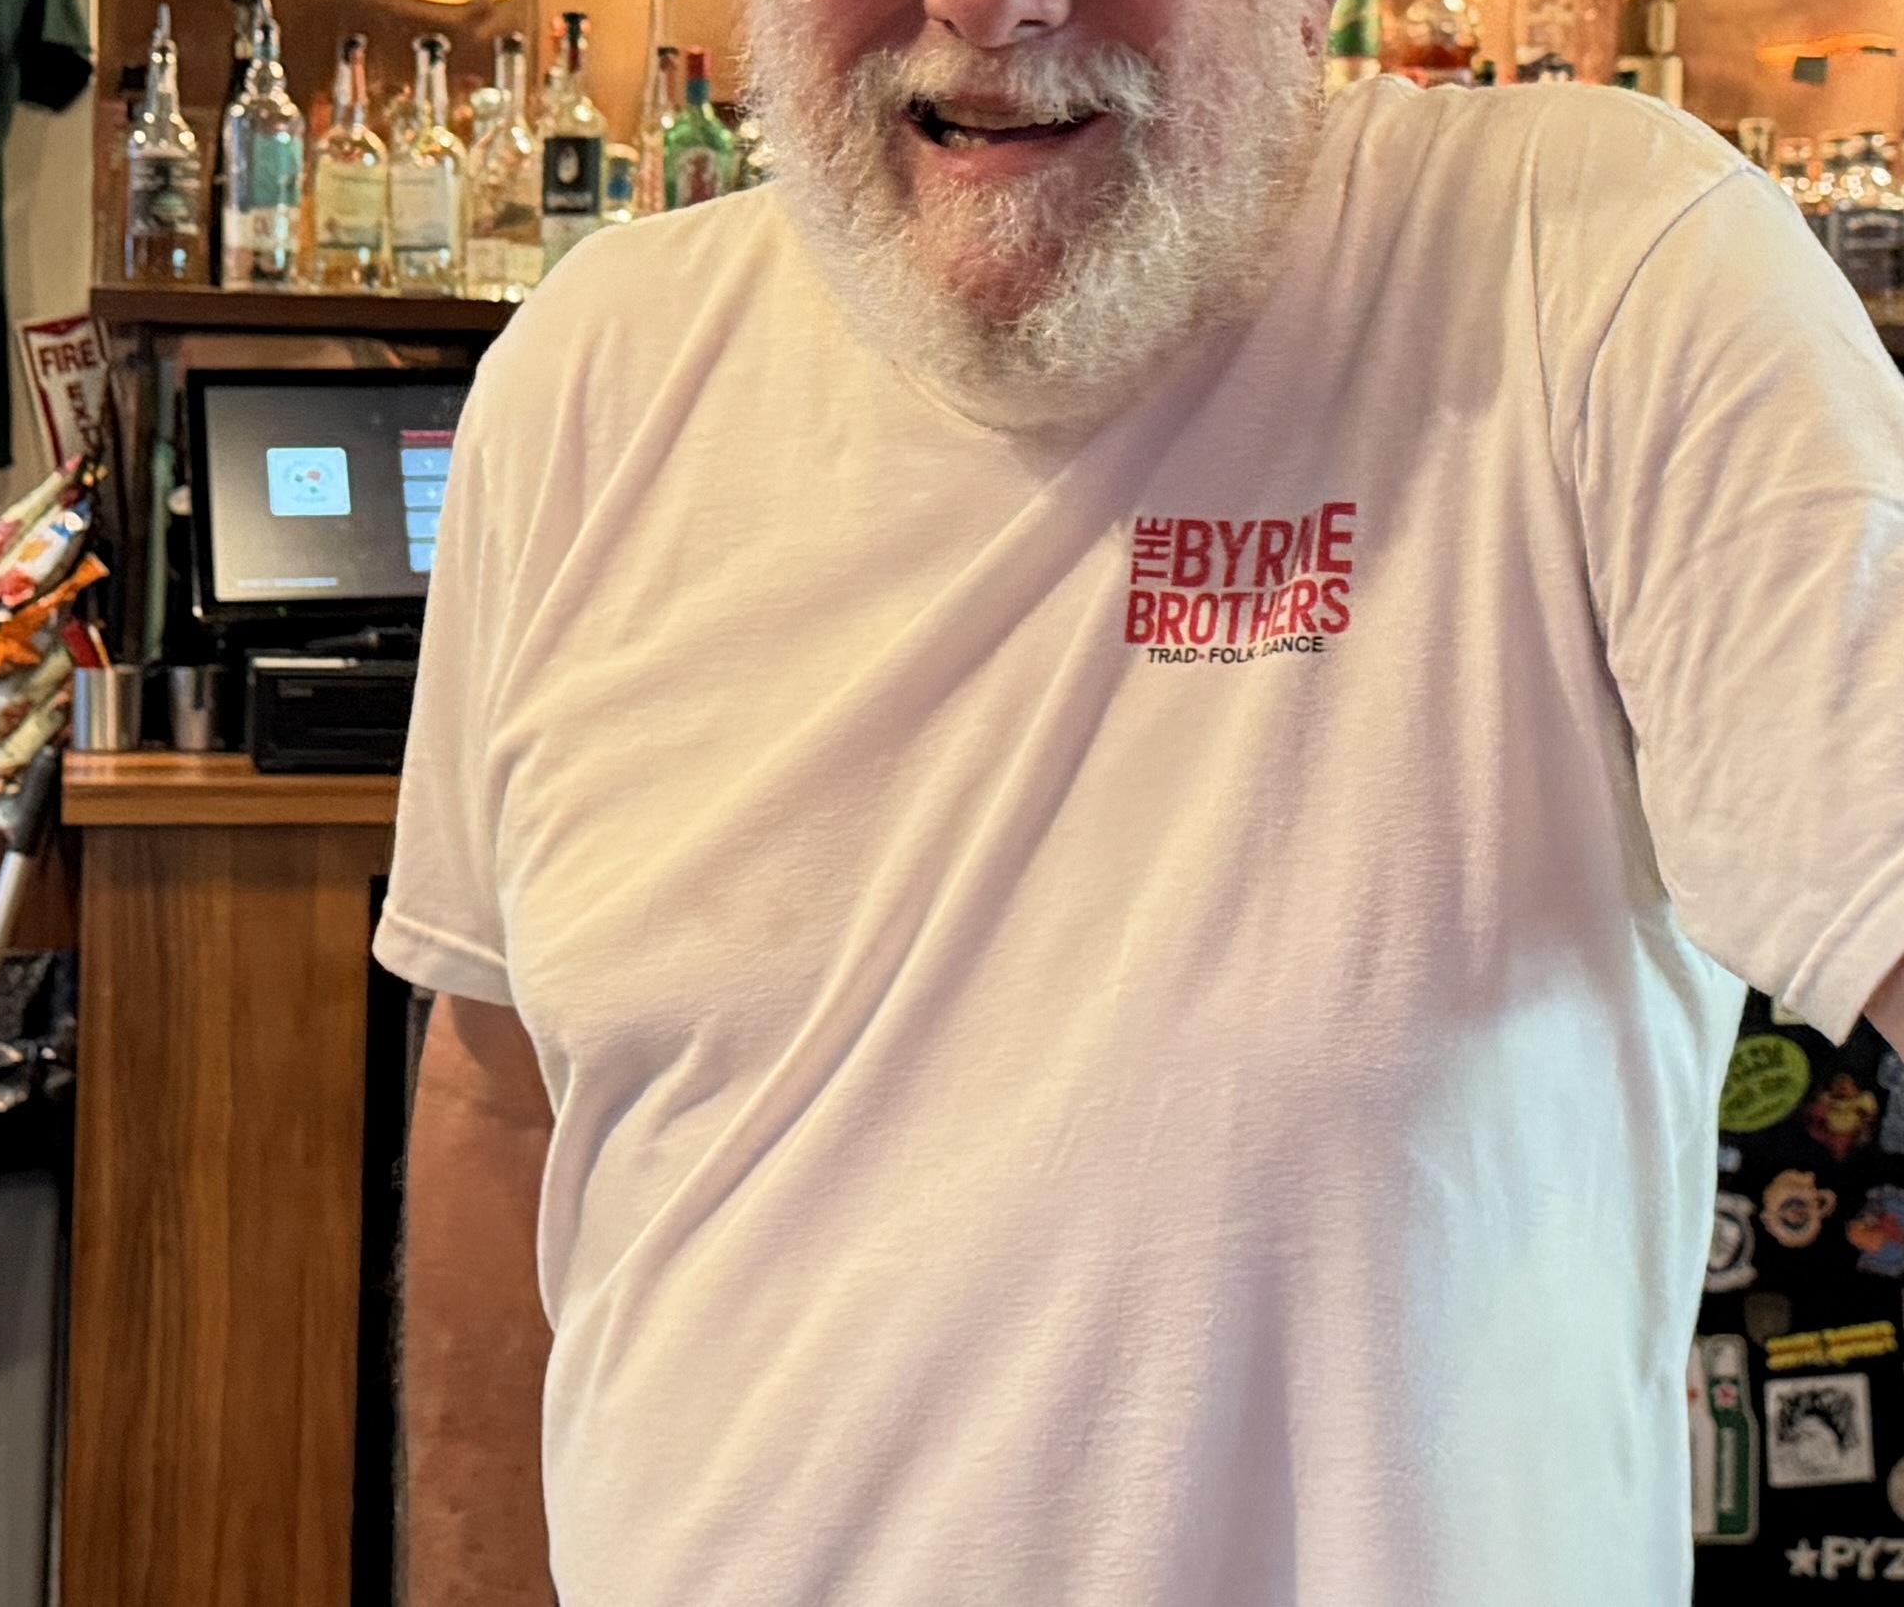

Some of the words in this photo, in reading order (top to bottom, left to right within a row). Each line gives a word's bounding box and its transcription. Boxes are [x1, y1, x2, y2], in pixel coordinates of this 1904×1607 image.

[37, 339, 98, 378] FIRE
[1130, 516, 1174, 586] THE
[1124, 577, 1352, 646] BROTHERS
[1146, 647, 1198, 665] TRAD
[1208, 645, 1257, 665] FOLK
